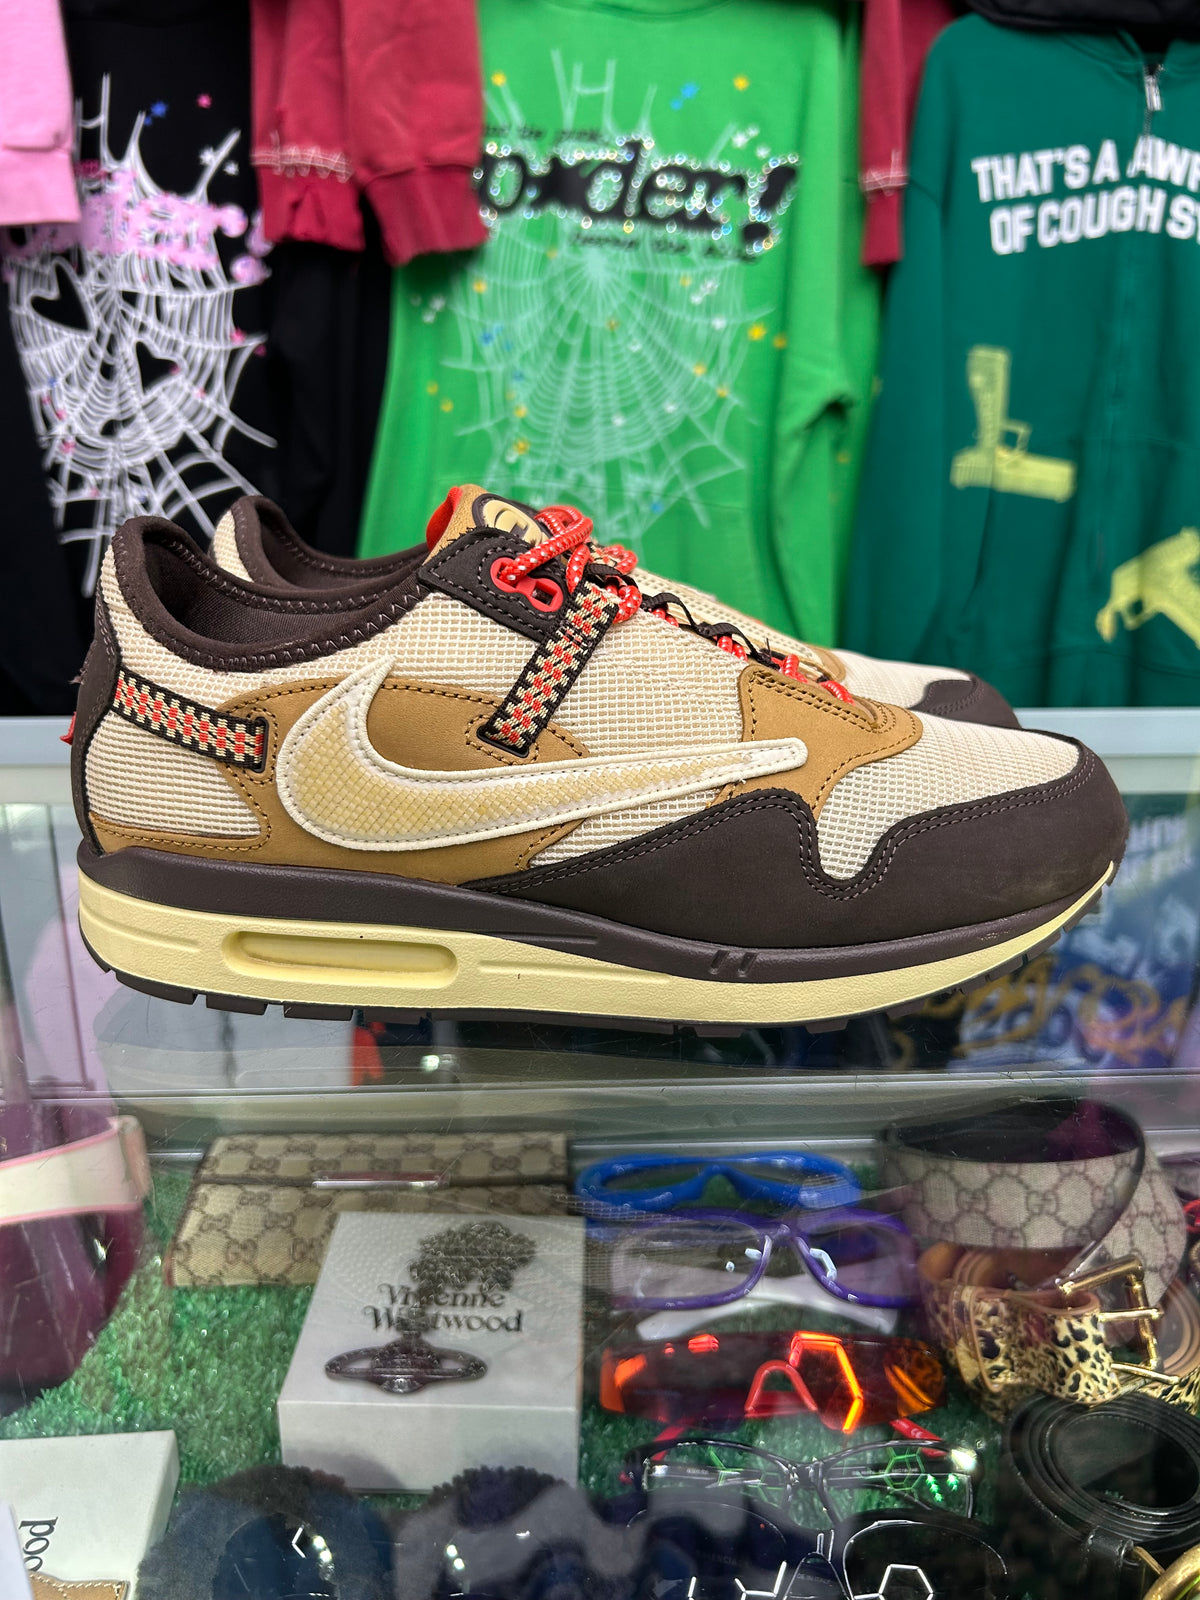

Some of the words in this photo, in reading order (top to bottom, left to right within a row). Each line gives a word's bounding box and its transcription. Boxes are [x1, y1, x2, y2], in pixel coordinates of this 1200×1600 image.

[971, 145, 1091, 203] THAT'S
[1092, 139, 1121, 185] A
[990, 203, 1036, 256] OF
[1037, 185, 1168, 248] COUGH
[1166, 194, 1200, 246] S
[363, 1305, 523, 1333] Wtwood
